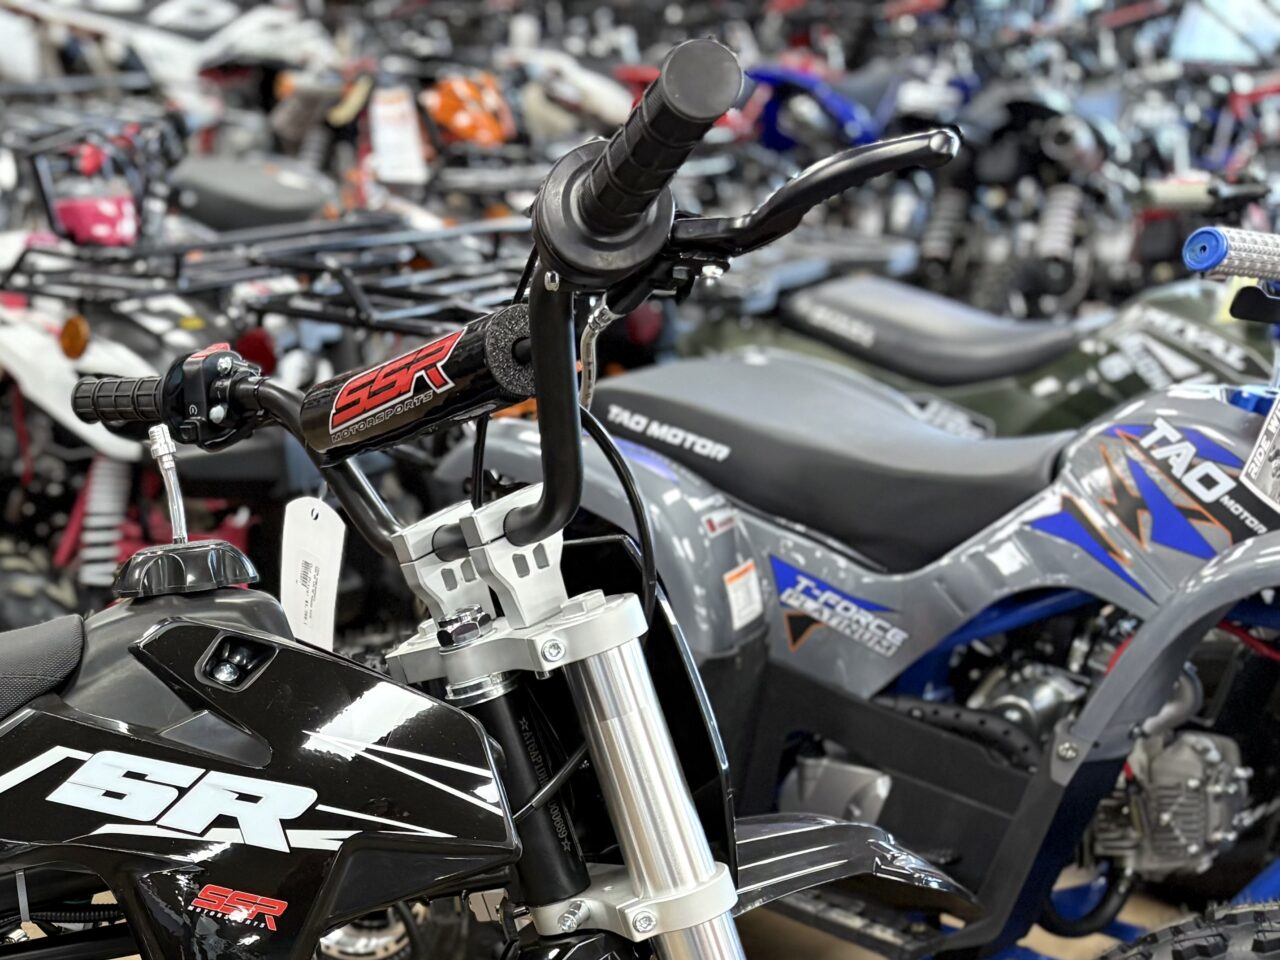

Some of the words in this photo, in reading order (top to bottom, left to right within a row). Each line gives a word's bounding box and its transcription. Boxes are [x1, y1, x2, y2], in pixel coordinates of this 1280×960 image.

[329, 326, 468, 435] SSR
[331, 390, 434, 443] MOTORSPORTS
[608, 403, 649, 433] TAO
[646, 420, 731, 462] MOTOR
[1139, 417, 1237, 503] TAO
[1248, 434, 1271, 480] RIDE
[1220, 494, 1268, 535] MOTOR
[795, 575, 909, 646] T-FORCE
[45, 750, 318, 853] SR
[190, 883, 289, 931] SSR
